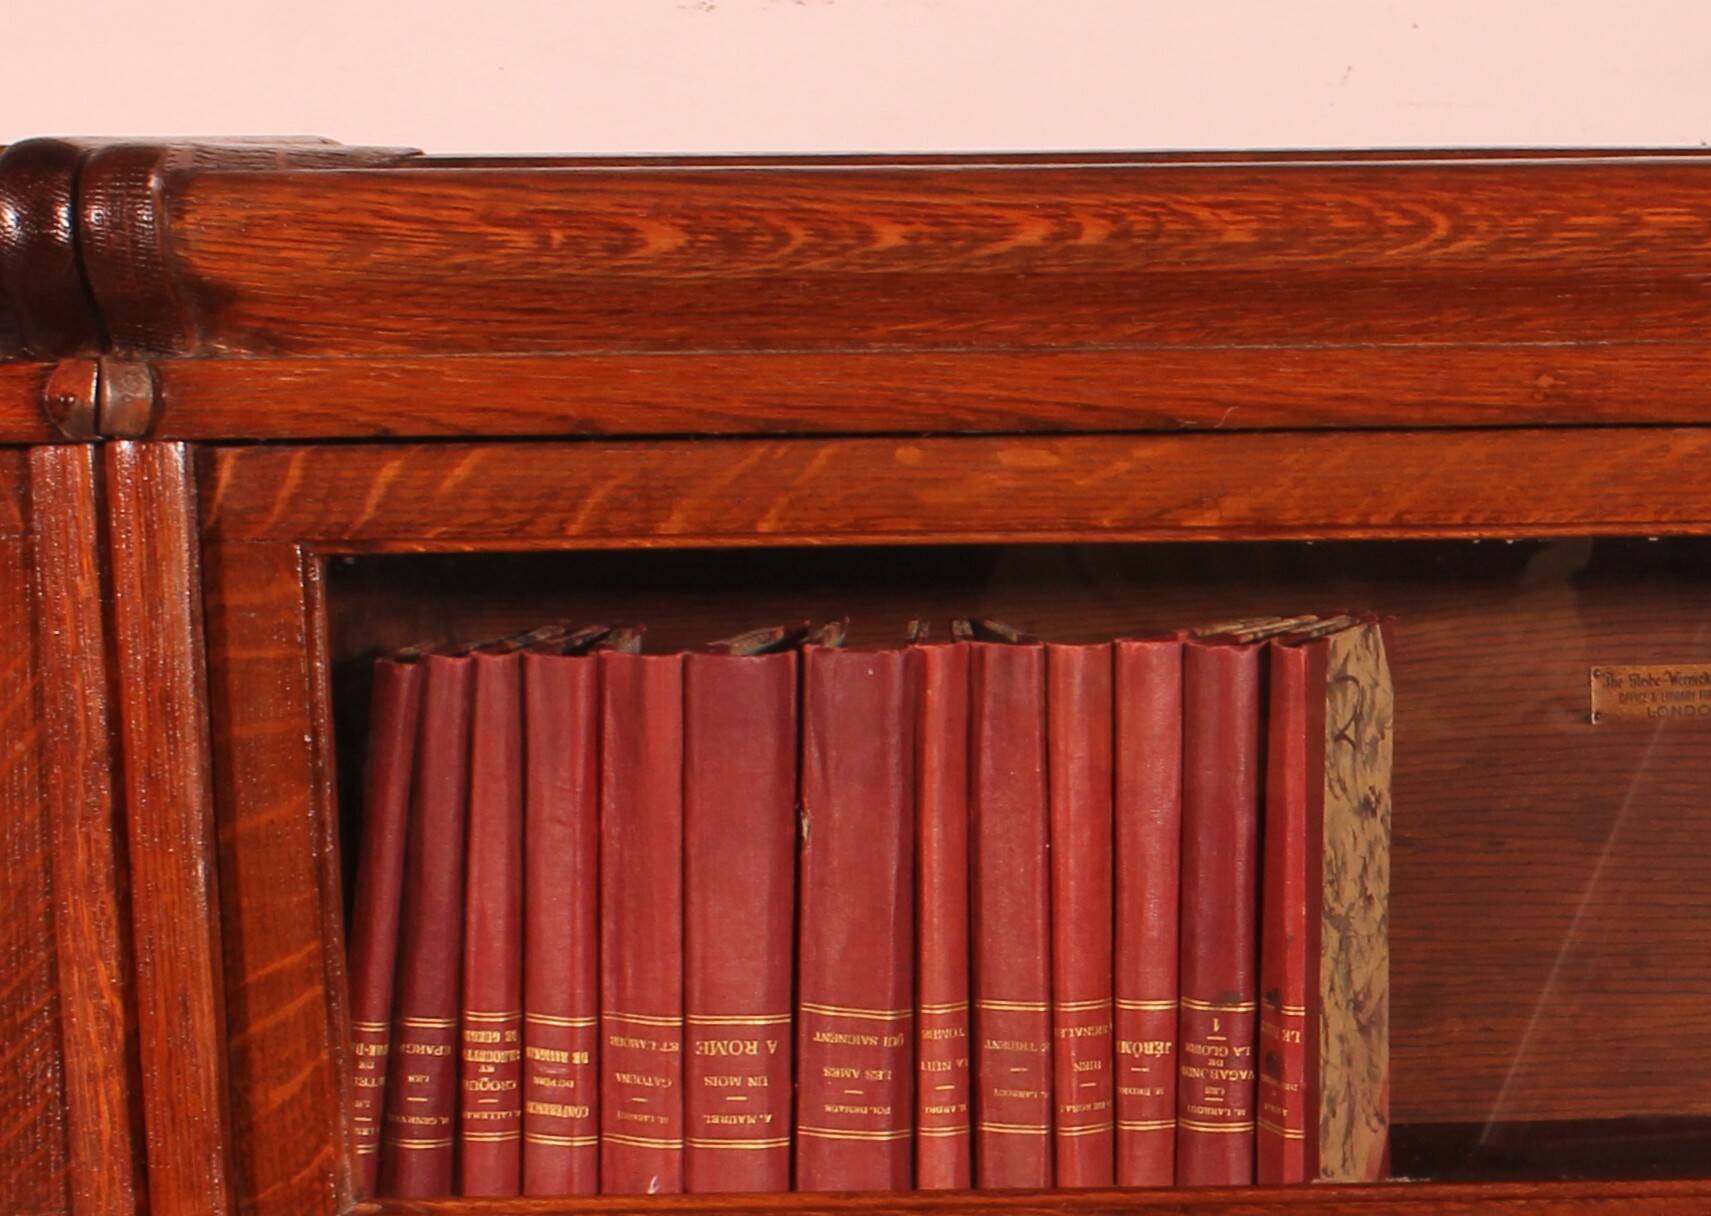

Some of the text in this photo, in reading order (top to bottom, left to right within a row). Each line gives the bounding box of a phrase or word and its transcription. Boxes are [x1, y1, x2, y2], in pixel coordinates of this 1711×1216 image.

[1213, 1018, 1221, 1033] 1
[813, 1032, 904, 1047] QUI SAIGNENT
[659, 1042, 679, 1052] ET
[696, 1040, 778, 1056] A ROME
[1117, 1041, 1172, 1058] JÉRÔM
[1233, 1047, 1251, 1057] LA
[824, 1068, 892, 1081] LES AMES
[704, 1076, 768, 1087] UN MOIS
[704, 1114, 772, 1124] A. MAUREL
